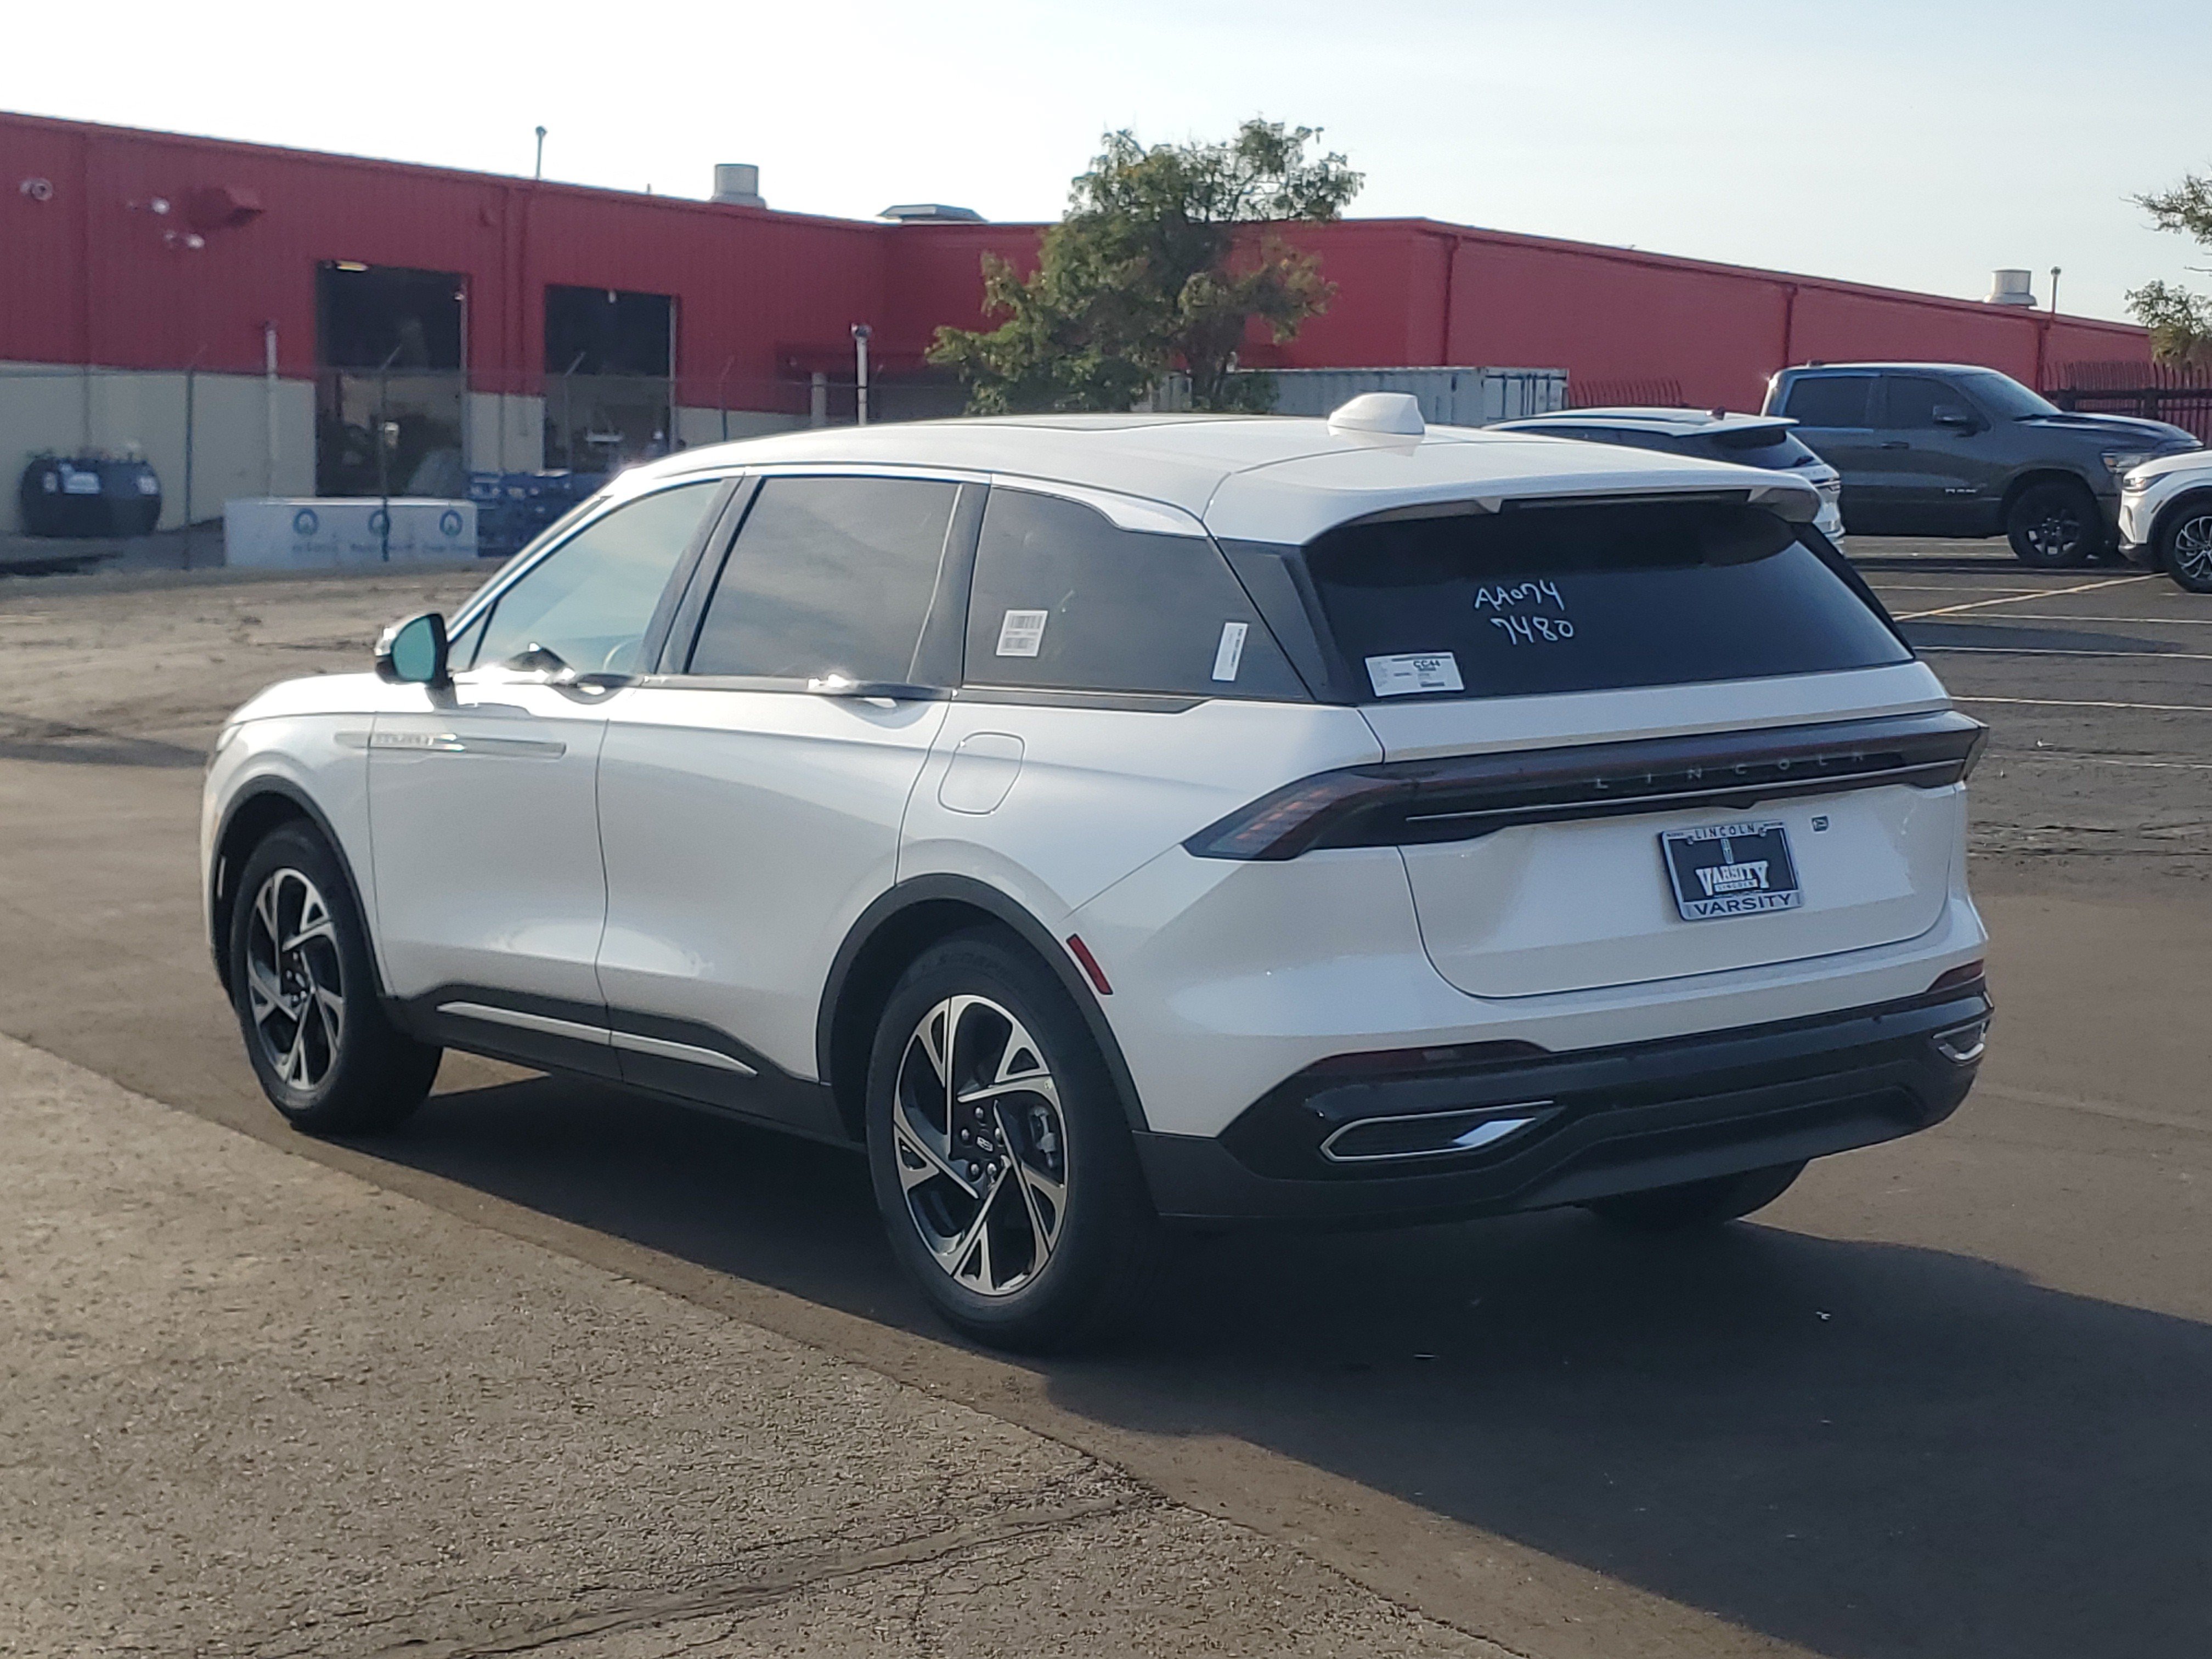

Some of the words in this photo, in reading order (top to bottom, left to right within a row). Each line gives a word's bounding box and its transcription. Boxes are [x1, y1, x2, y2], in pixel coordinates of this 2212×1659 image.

[1490, 614, 1574, 645] 7480
[1596, 751, 1863, 789] LINCOLN
[1695, 823, 1755, 840] LINCOLN
[1695, 861, 1770, 896] VARSITY
[1694, 893, 1791, 916] VARSITY
